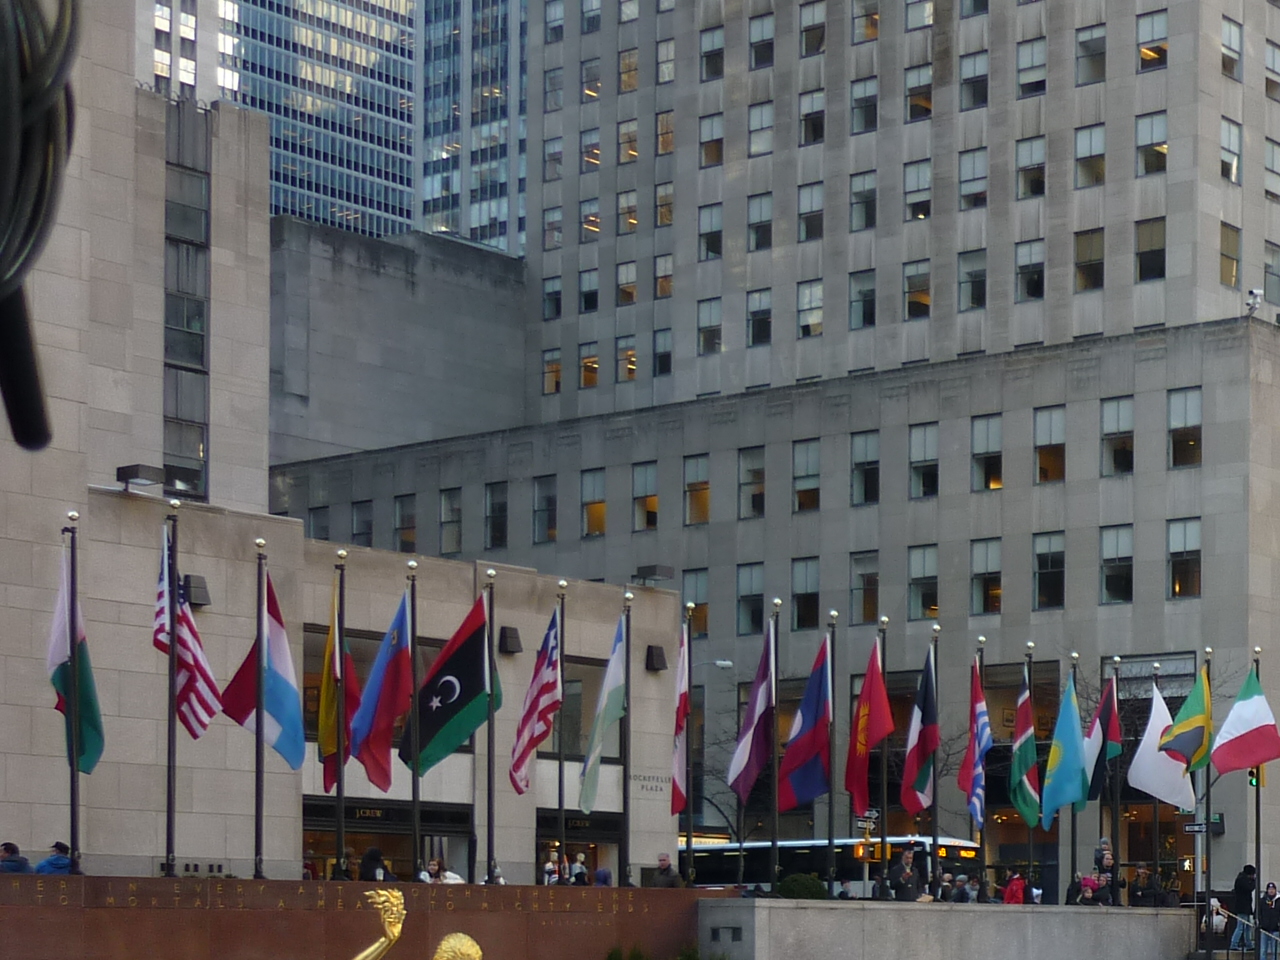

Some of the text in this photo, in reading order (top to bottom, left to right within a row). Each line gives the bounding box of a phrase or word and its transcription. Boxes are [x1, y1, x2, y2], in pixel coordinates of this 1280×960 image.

[628, 774, 672, 783] OCKEFELLE
[107, 882, 137, 892] IN
[174, 882, 265, 895] EVERY
[298, 886, 343, 895] ART
[515, 889, 555, 900] THE
[36, 894, 68, 906] TO
[106, 896, 244, 910] MORTALS
[430, 900, 455, 911] TO
[481, 902, 571, 912] MIGHTY
